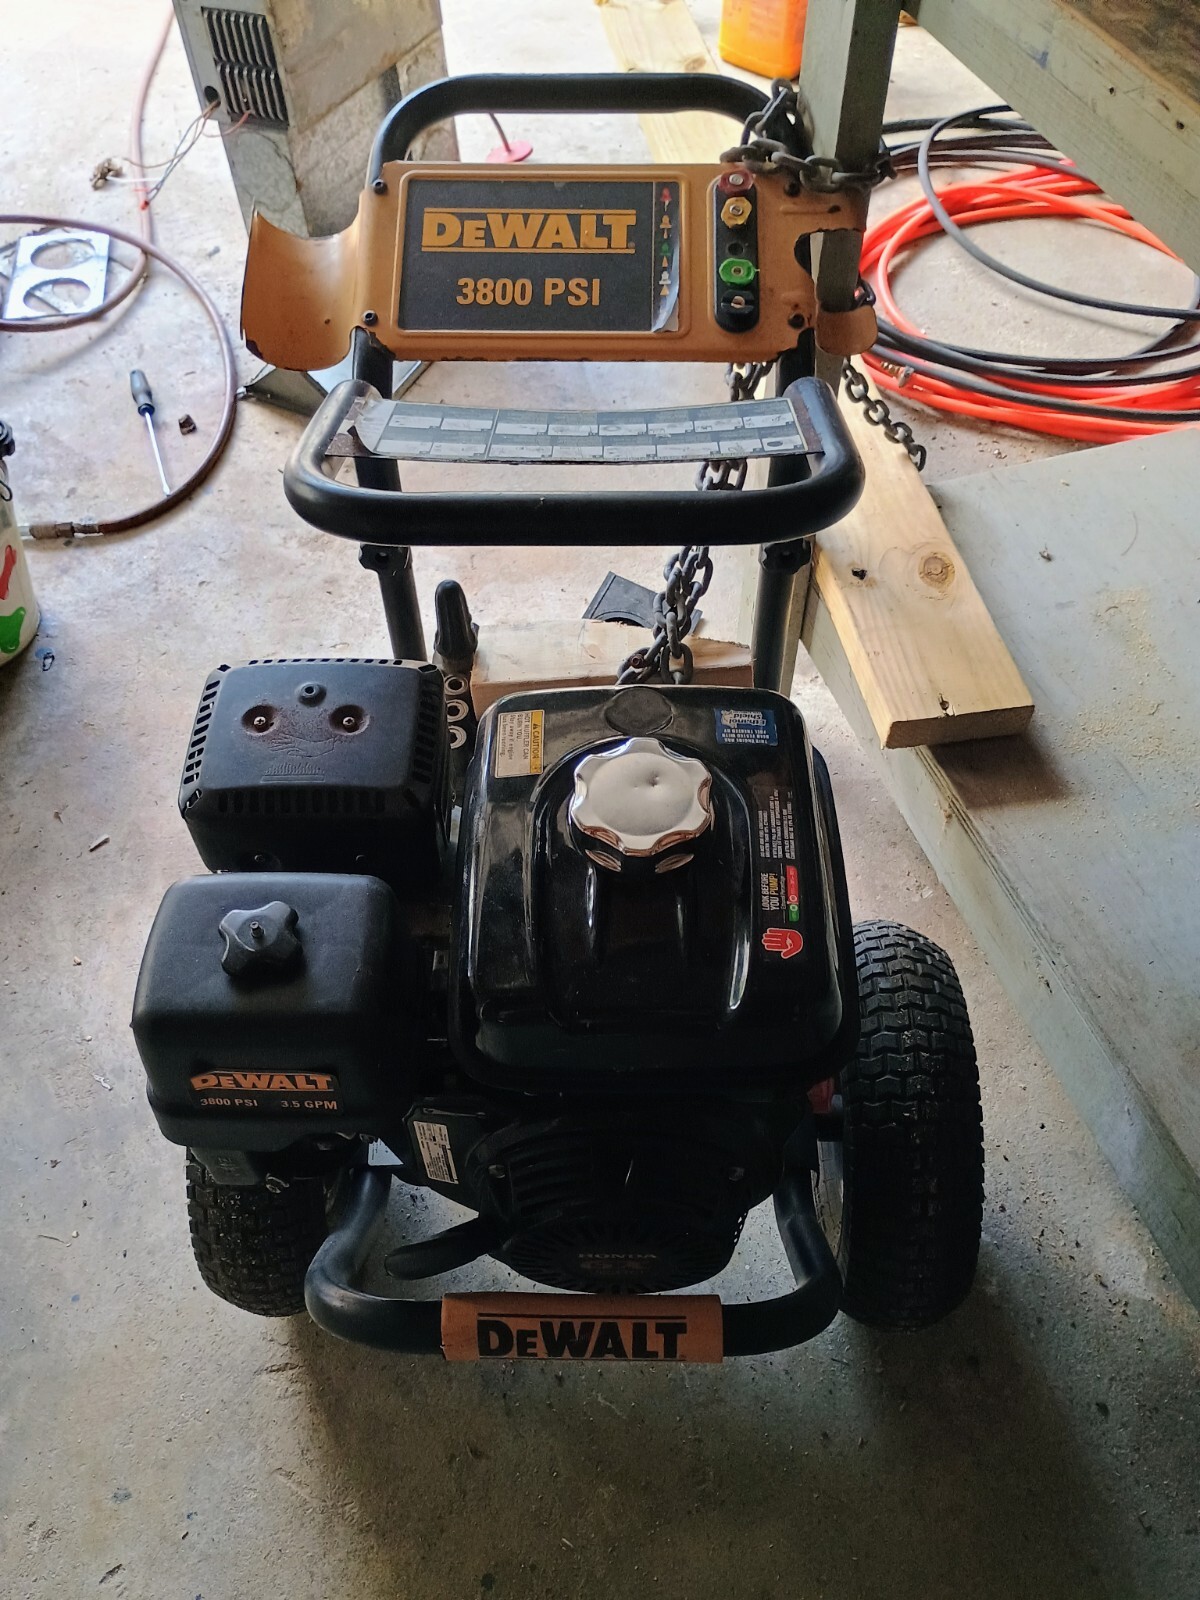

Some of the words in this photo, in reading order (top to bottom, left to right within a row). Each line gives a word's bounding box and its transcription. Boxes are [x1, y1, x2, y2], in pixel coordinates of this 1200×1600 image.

[456, 277, 533, 306] 3800
[544, 277, 601, 306] PSI
[532, 731, 540, 759] CAUTION
[761, 873, 769, 895] BEFORE
[769, 872, 779, 896] PUMP!
[769, 896, 779, 911] YOU
[200, 1097, 231, 1106] 3800
[235, 1098, 258, 1107] PSI
[281, 1100, 300, 1108] 3.5
[304, 1100, 338, 1110] GPM
